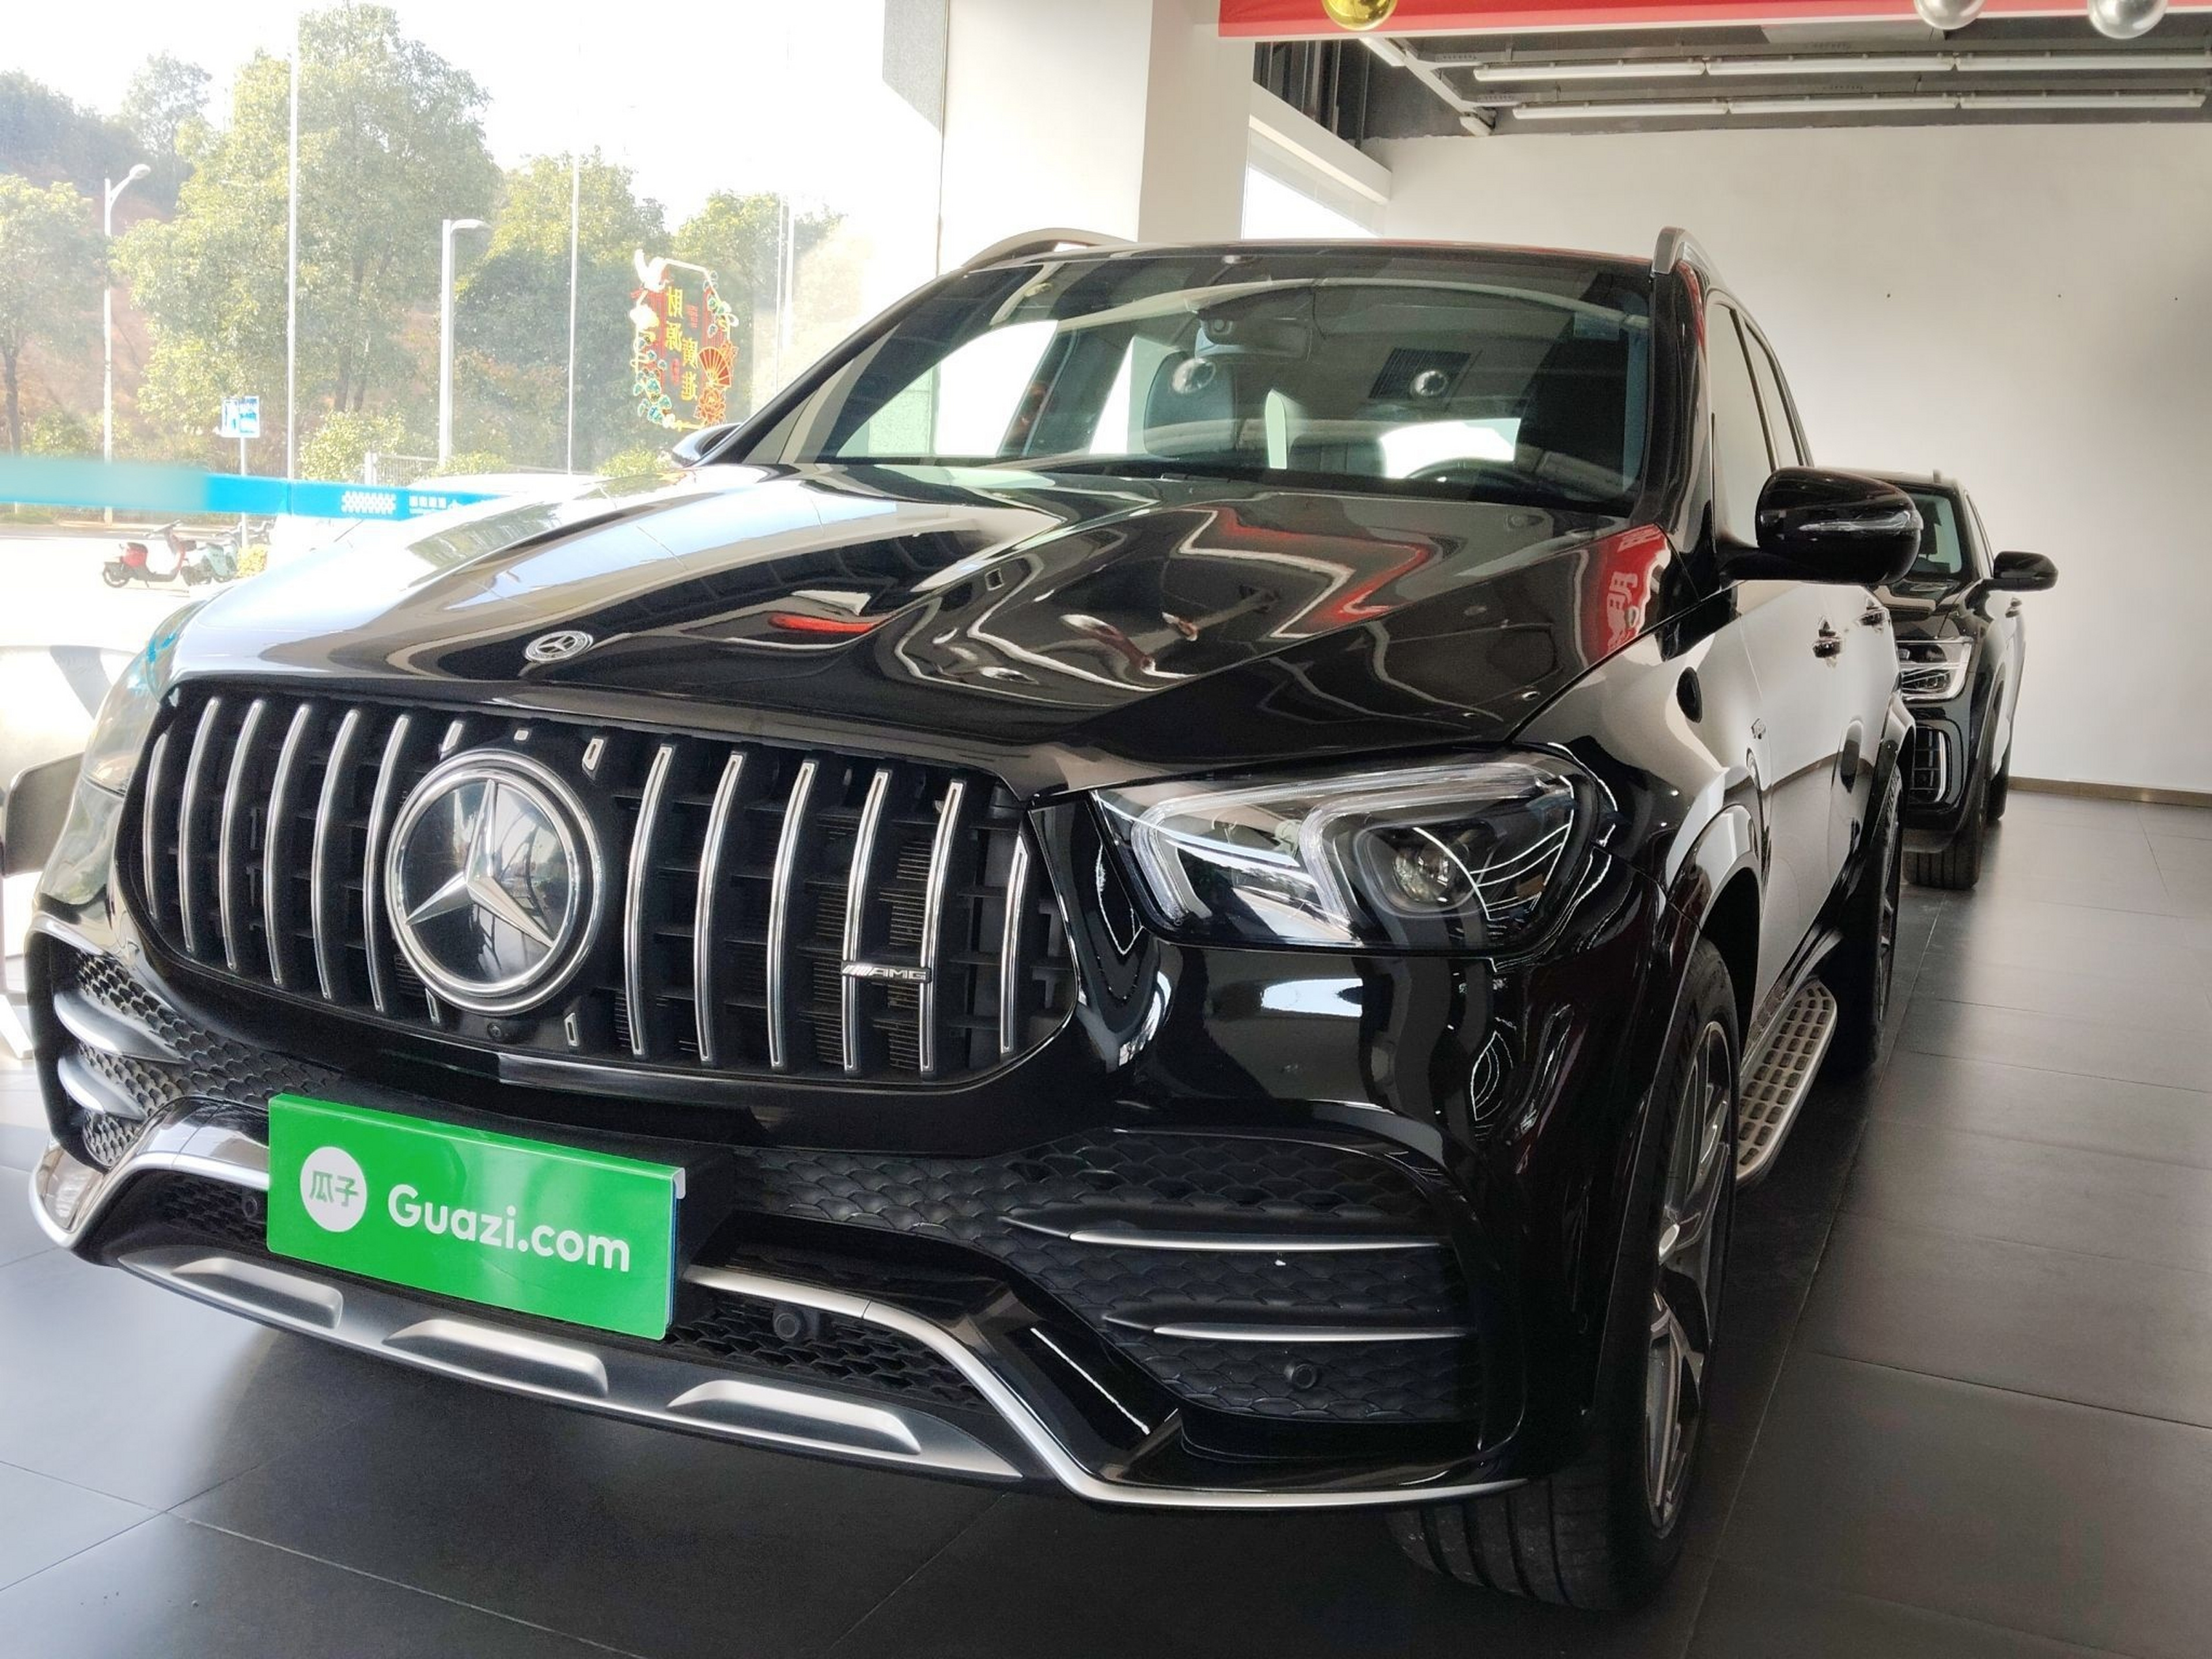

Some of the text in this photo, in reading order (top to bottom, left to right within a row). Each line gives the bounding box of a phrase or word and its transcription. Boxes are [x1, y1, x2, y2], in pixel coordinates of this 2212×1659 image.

[869, 967, 926, 980] AMG
[309, 1169, 359, 1208] 瓜子
[388, 1183, 631, 1272] Guazi.com
